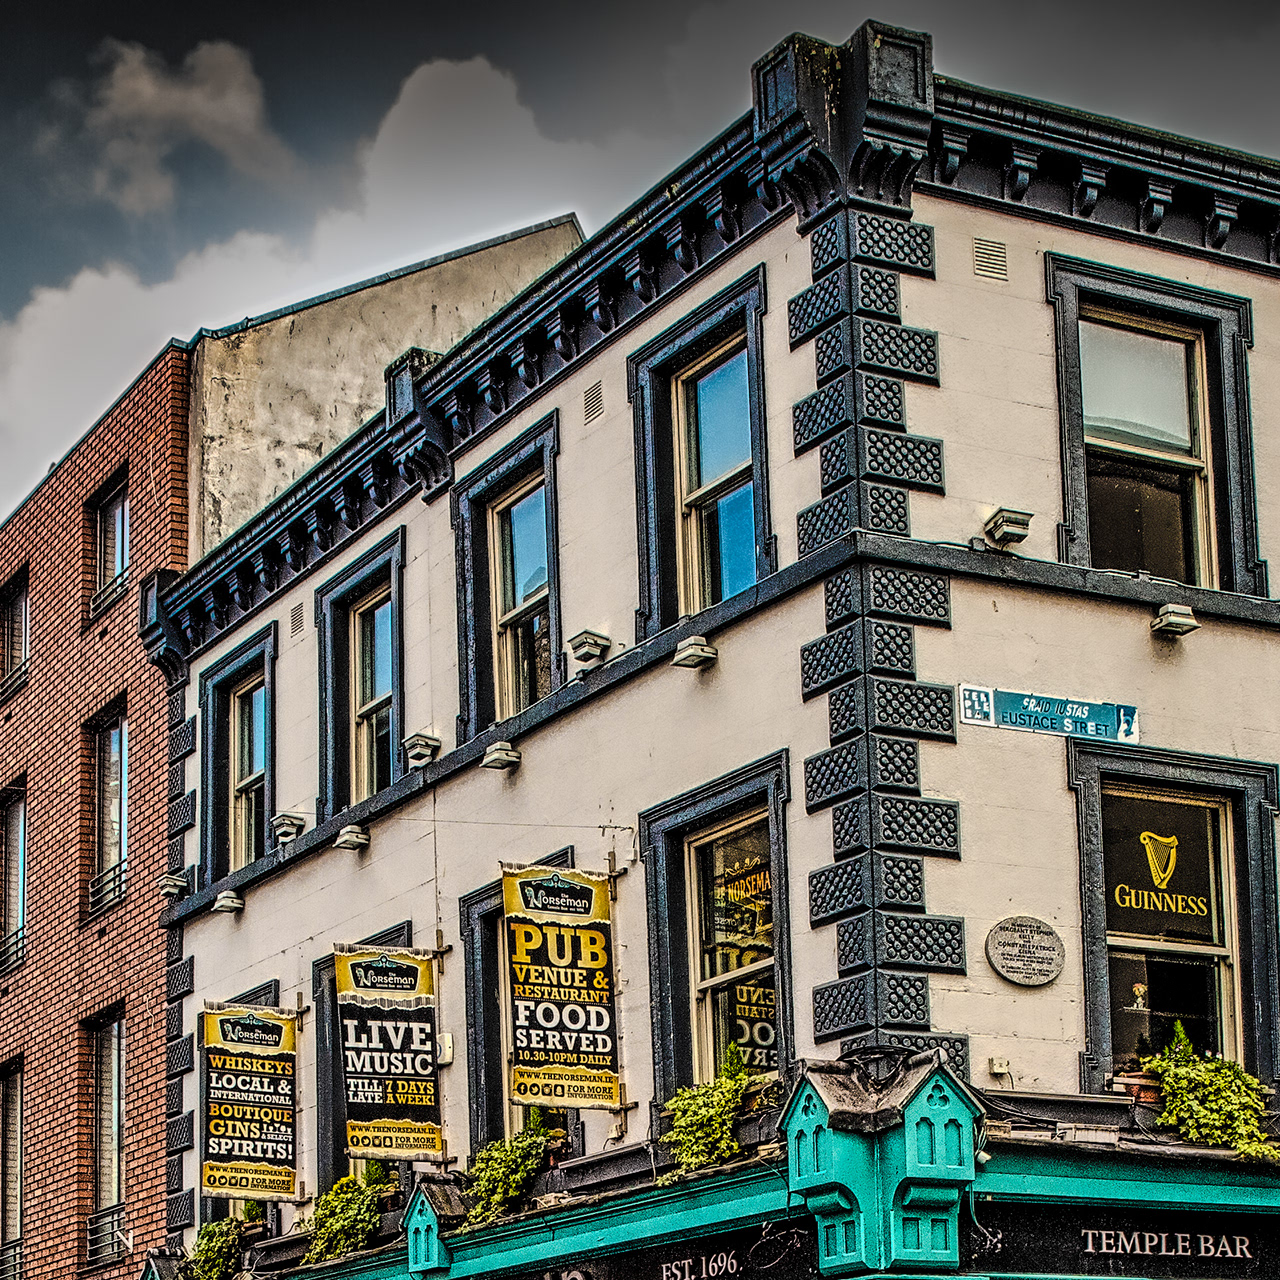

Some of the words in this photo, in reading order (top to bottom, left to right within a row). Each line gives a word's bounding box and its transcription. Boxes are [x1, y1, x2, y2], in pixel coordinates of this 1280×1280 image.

[1002, 712, 1057, 729] EUSTACE
[1064, 718, 1109, 736] STREET
[526, 887, 588, 909] Norseman
[1114, 883, 1208, 917] GUINNESS
[511, 923, 607, 969] PUB
[357, 968, 414, 985] Norseman
[513, 964, 587, 988] VENUE
[593, 971, 609, 988] &
[513, 984, 609, 1003] RESTAURANT
[515, 1000, 610, 1031] FOOD
[224, 1022, 279, 1042] Norseman
[343, 1019, 431, 1050] LIVE
[516, 1029, 612, 1052] SERVED
[209, 1055, 292, 1075] WHISKEYS
[345, 1051, 433, 1074] MUSIC
[518, 1051, 577, 1063] 10.30-10PM
[580, 1054, 612, 1065] DAILY
[210, 1073, 274, 1093] LOCAL
[278, 1080, 291, 1094] &
[347, 1079, 382, 1092] TILL
[517, 1071, 613, 1083] WWW.THENORSEMAN.IE
[210, 1090, 291, 1105] INTERNATIONAL
[348, 1092, 383, 1103] LATE
[386, 1081, 392, 1092] 7
[397, 1081, 434, 1094] DAYS
[568, 1085, 585, 1093] FOR
[589, 1086, 613, 1094] MORE
[387, 1094, 397, 1104] A
[398, 1094, 434, 1105] WEEK!
[209, 1103, 292, 1123] BOUTIQUE
[209, 1119, 260, 1139] GINS
[267, 1134, 292, 1142] SELECT
[350, 1125, 435, 1134] WWW.THENORSEMAN.IE
[209, 1138, 292, 1160] SPIRITS!
[208, 1165, 291, 1178] WWW.THENORSEMAN.IE
[268, 1178, 291, 1186] MORE
[1081, 1229, 1192, 1256] TEMPLE
[1198, 1232, 1252, 1259] BAR
[699, 1254, 739, 1280] 1696
